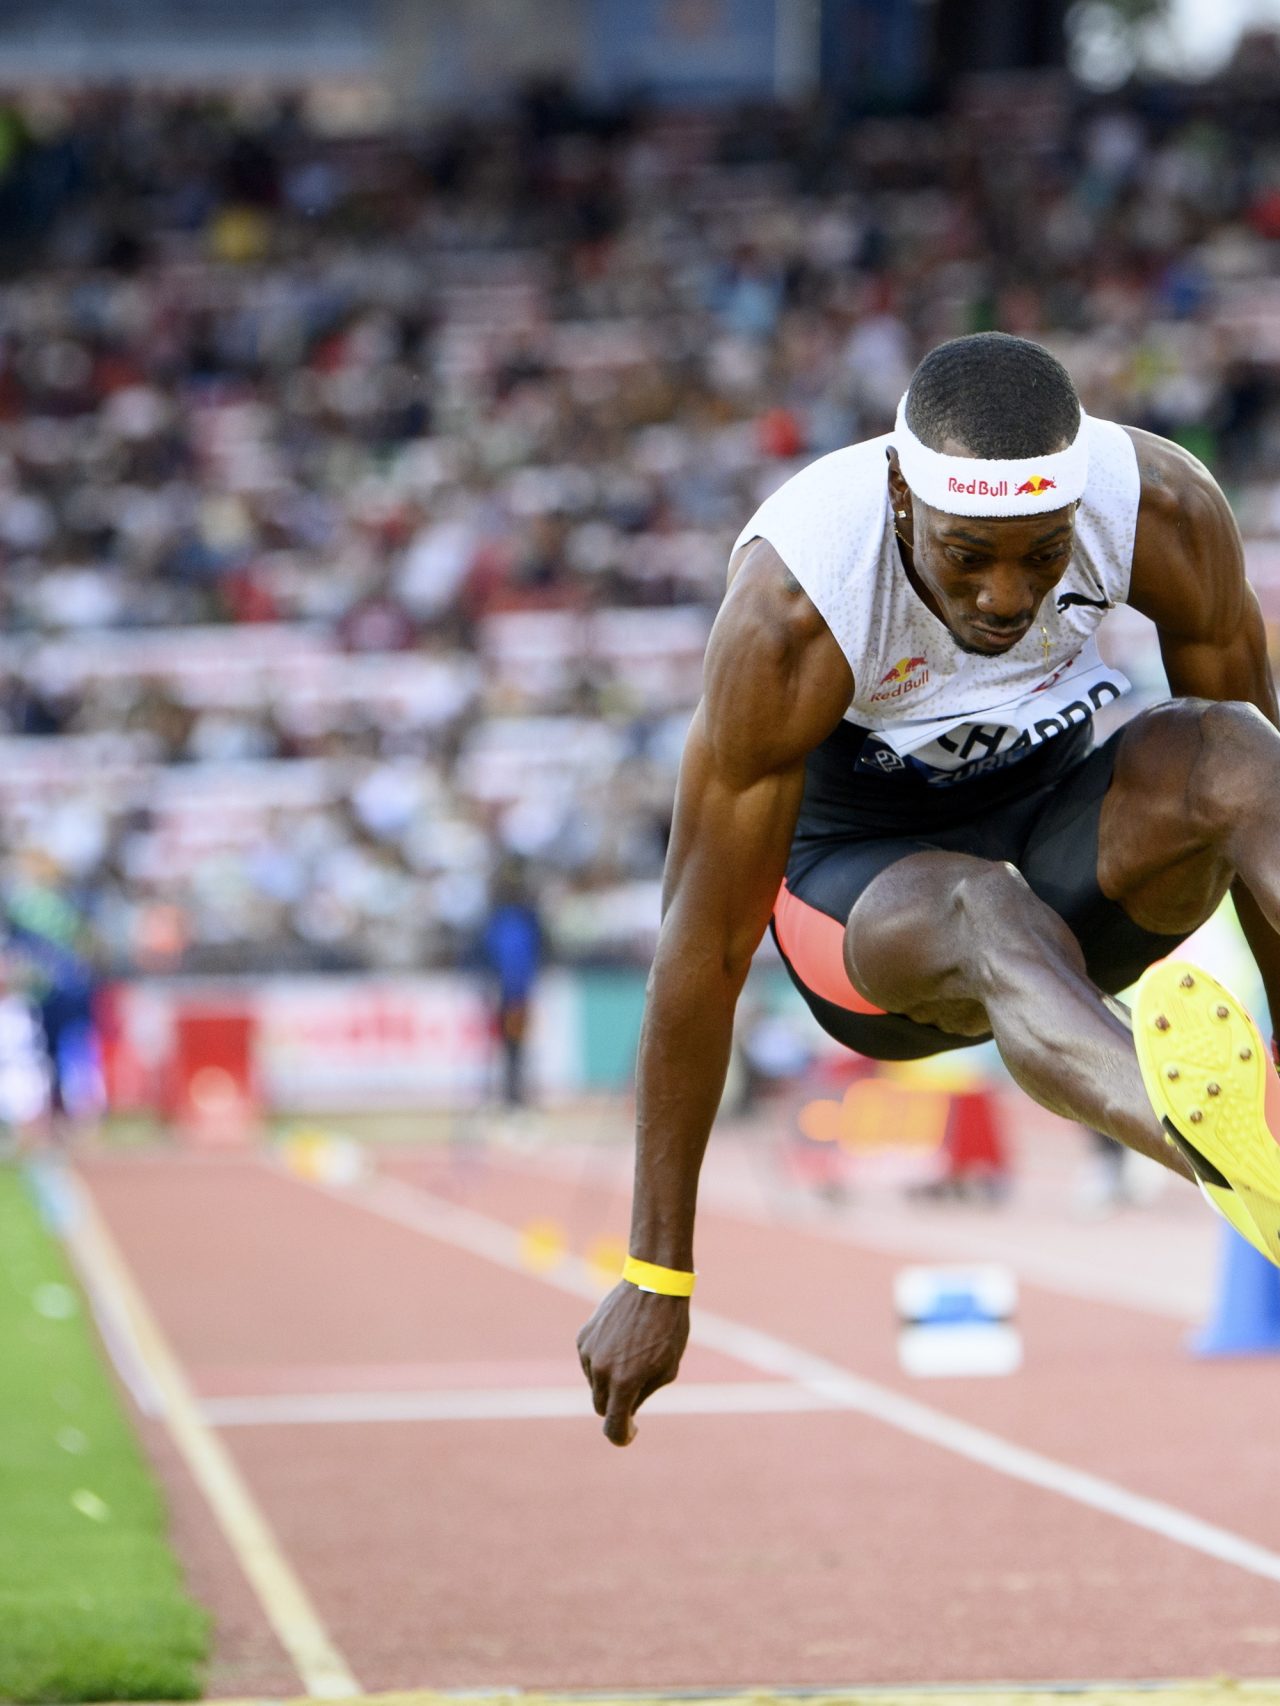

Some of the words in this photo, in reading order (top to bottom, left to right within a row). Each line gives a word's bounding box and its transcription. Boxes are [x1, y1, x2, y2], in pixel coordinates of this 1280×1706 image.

[948, 477, 976, 495] Red
[978, 480, 1008, 497] Bull
[870, 684, 902, 703] Red
[904, 669, 929, 693] Bull
